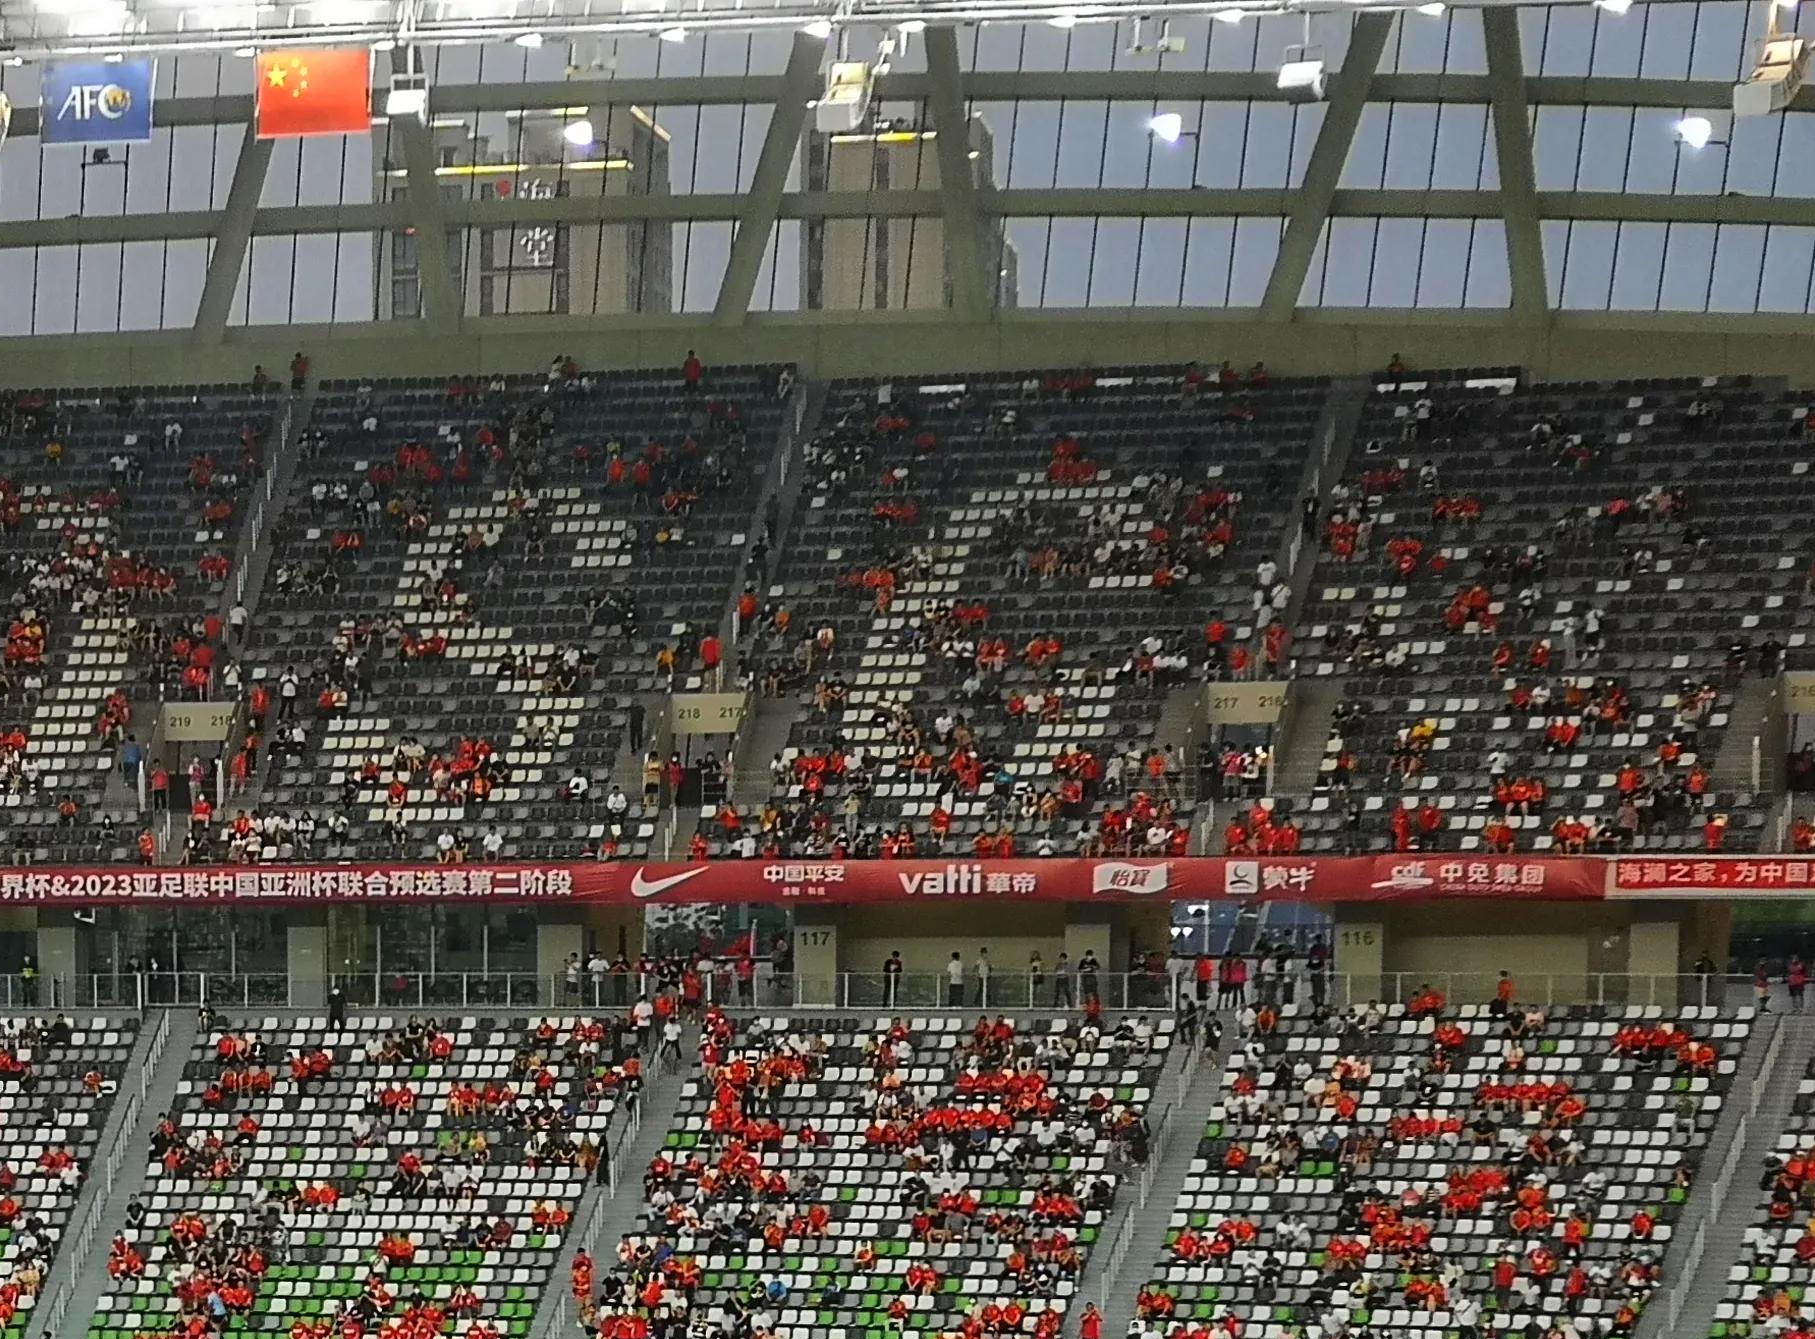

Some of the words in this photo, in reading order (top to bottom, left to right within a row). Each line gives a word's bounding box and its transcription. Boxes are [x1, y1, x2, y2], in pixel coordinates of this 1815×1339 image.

[1214, 697, 1238, 708] 217
[678, 708, 700, 719] 218
[719, 707, 741, 718] 217
[170, 716, 191, 727] 219
[764, 864, 844, 882] 中国平安
[899, 864, 982, 894] vatti
[1439, 862, 1545, 885] 中免集团
[1618, 862, 1815, 883] 海澜之家，为中国
[800, 932, 829, 946] 117
